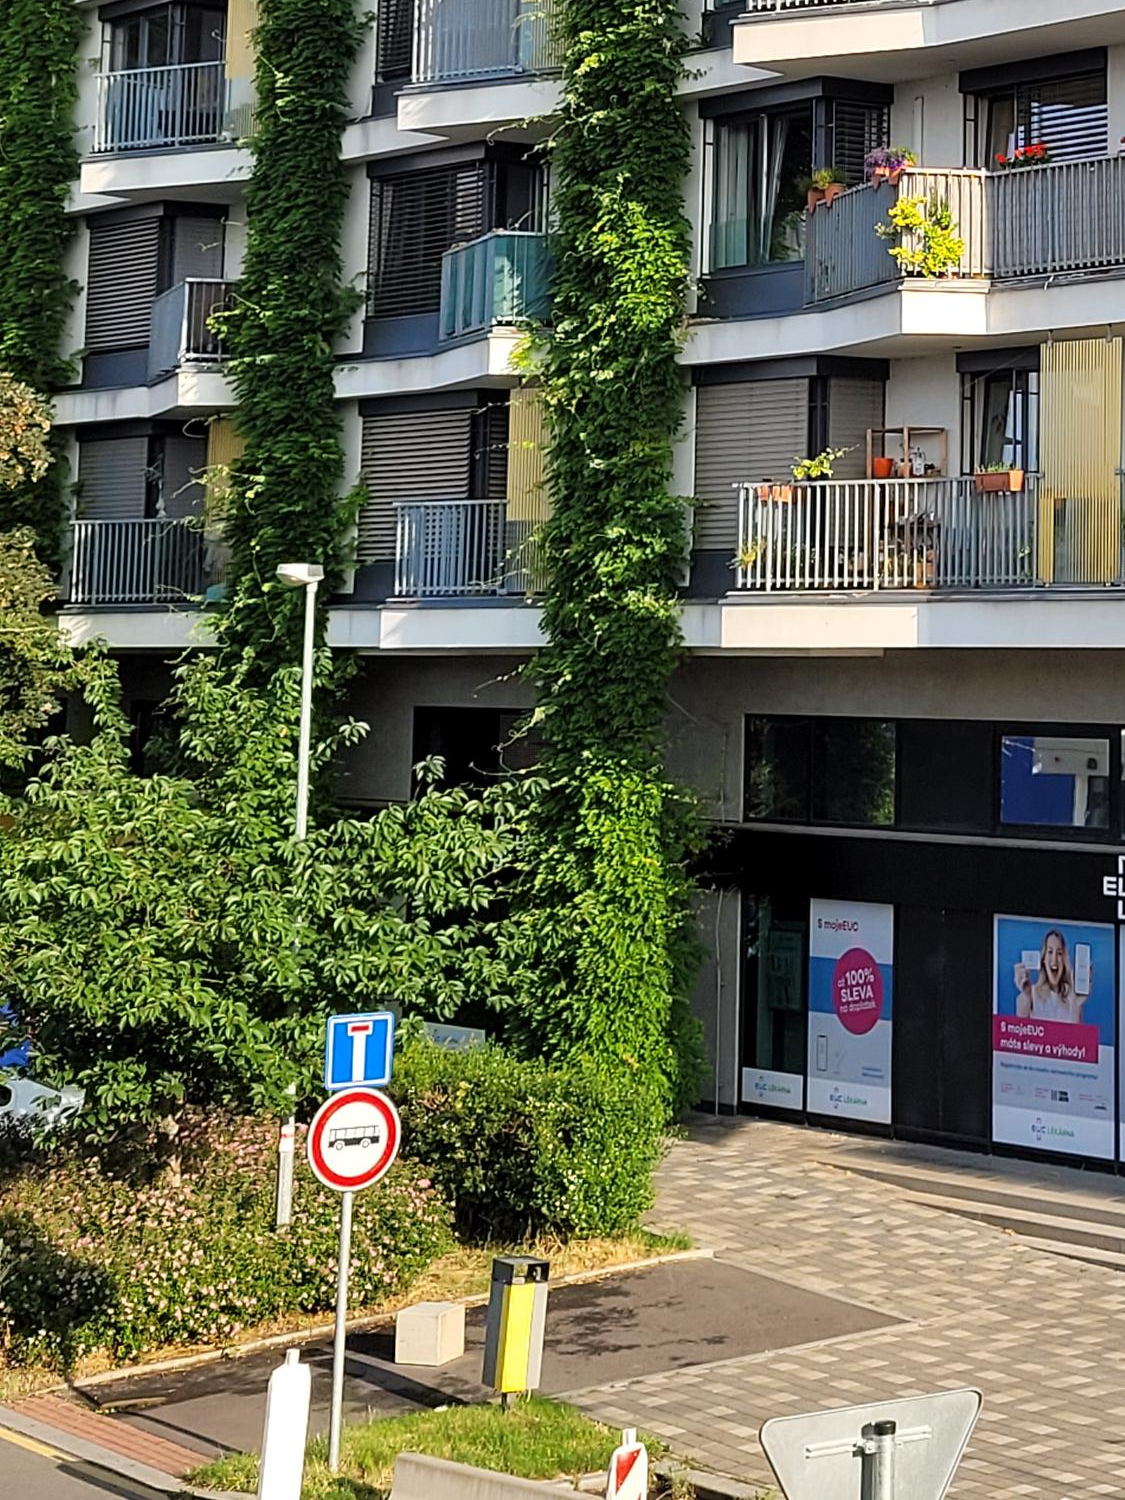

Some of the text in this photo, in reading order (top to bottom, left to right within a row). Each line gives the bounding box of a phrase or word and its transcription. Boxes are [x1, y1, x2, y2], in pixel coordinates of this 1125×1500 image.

[818, 918, 858, 932] S mojeEUC
[845, 967, 875, 986] 100%
[840, 985, 874, 1002] SLEVA
[1023, 1040, 1043, 1054] slevy
